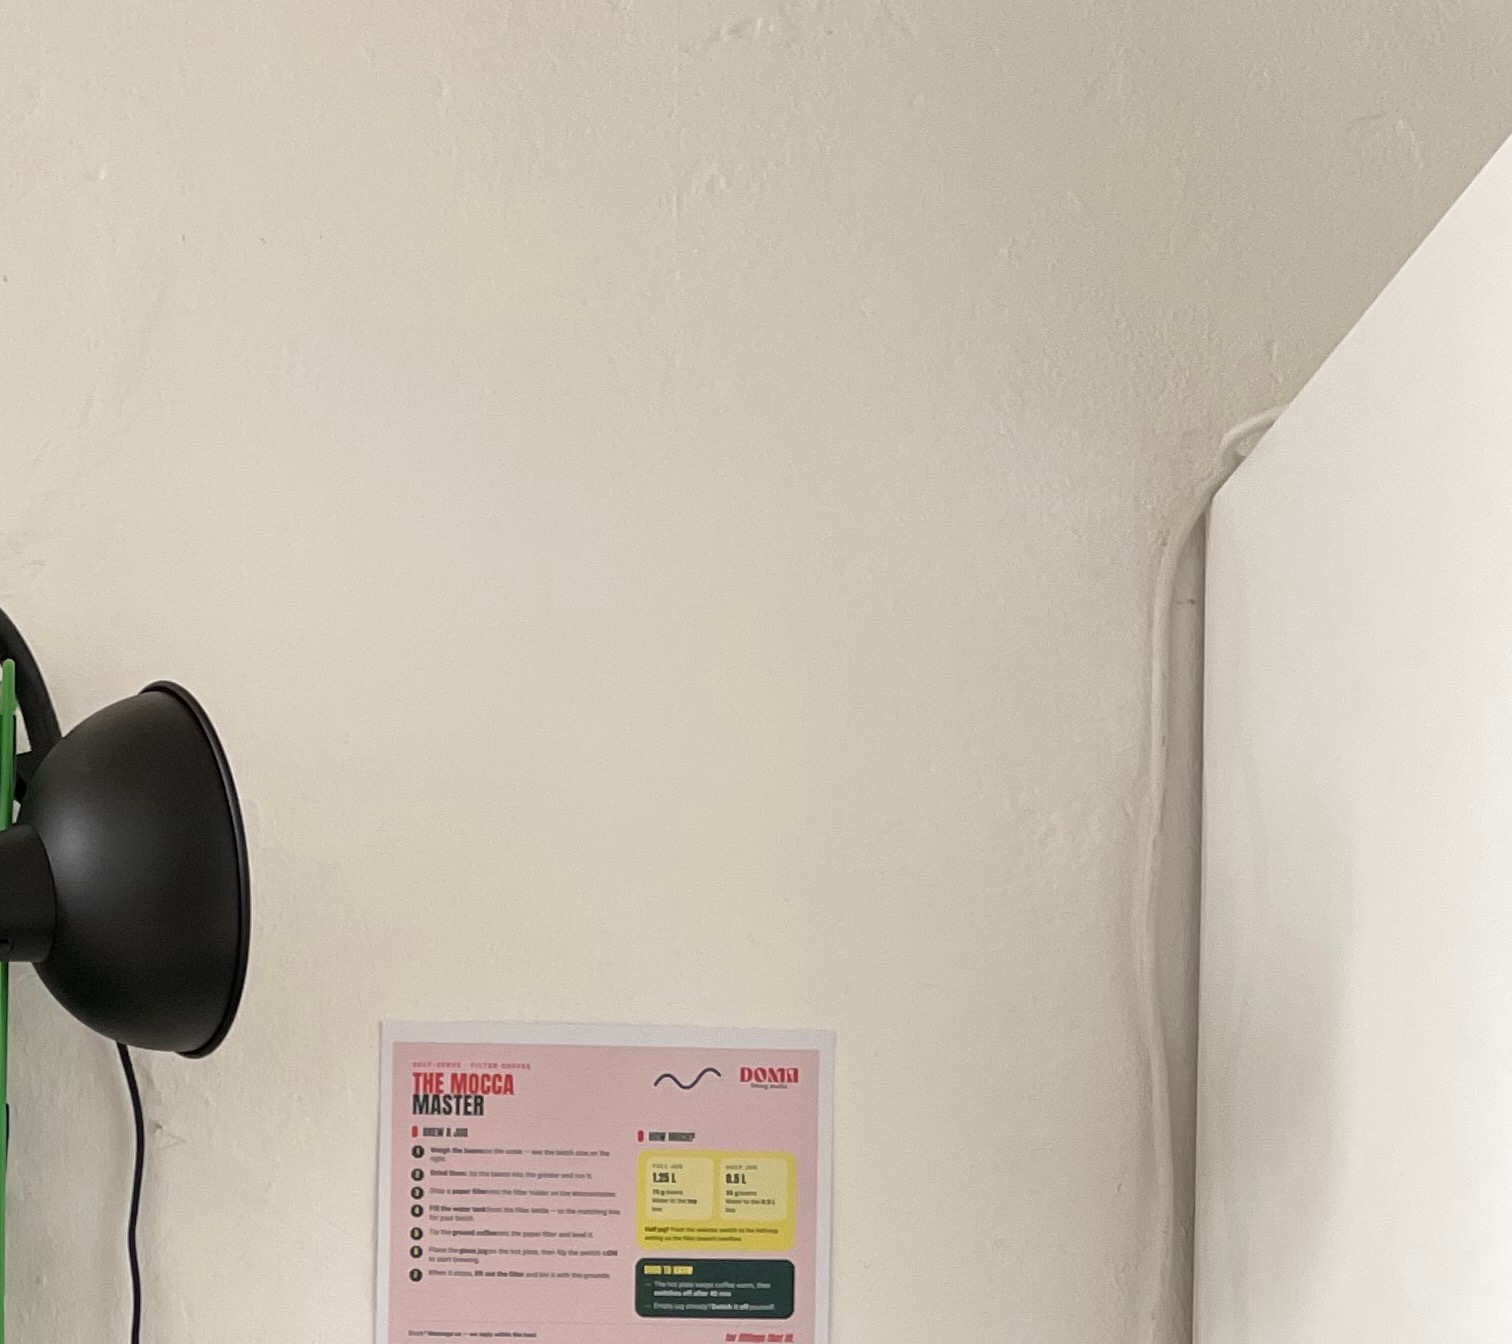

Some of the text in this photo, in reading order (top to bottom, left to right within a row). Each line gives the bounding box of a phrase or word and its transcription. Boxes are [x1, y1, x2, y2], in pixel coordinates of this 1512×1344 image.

[413, 1073, 514, 1095] THE MOCCA
[413, 1095, 484, 1115] MASTER
[652, 1173, 669, 1183] 1.25
